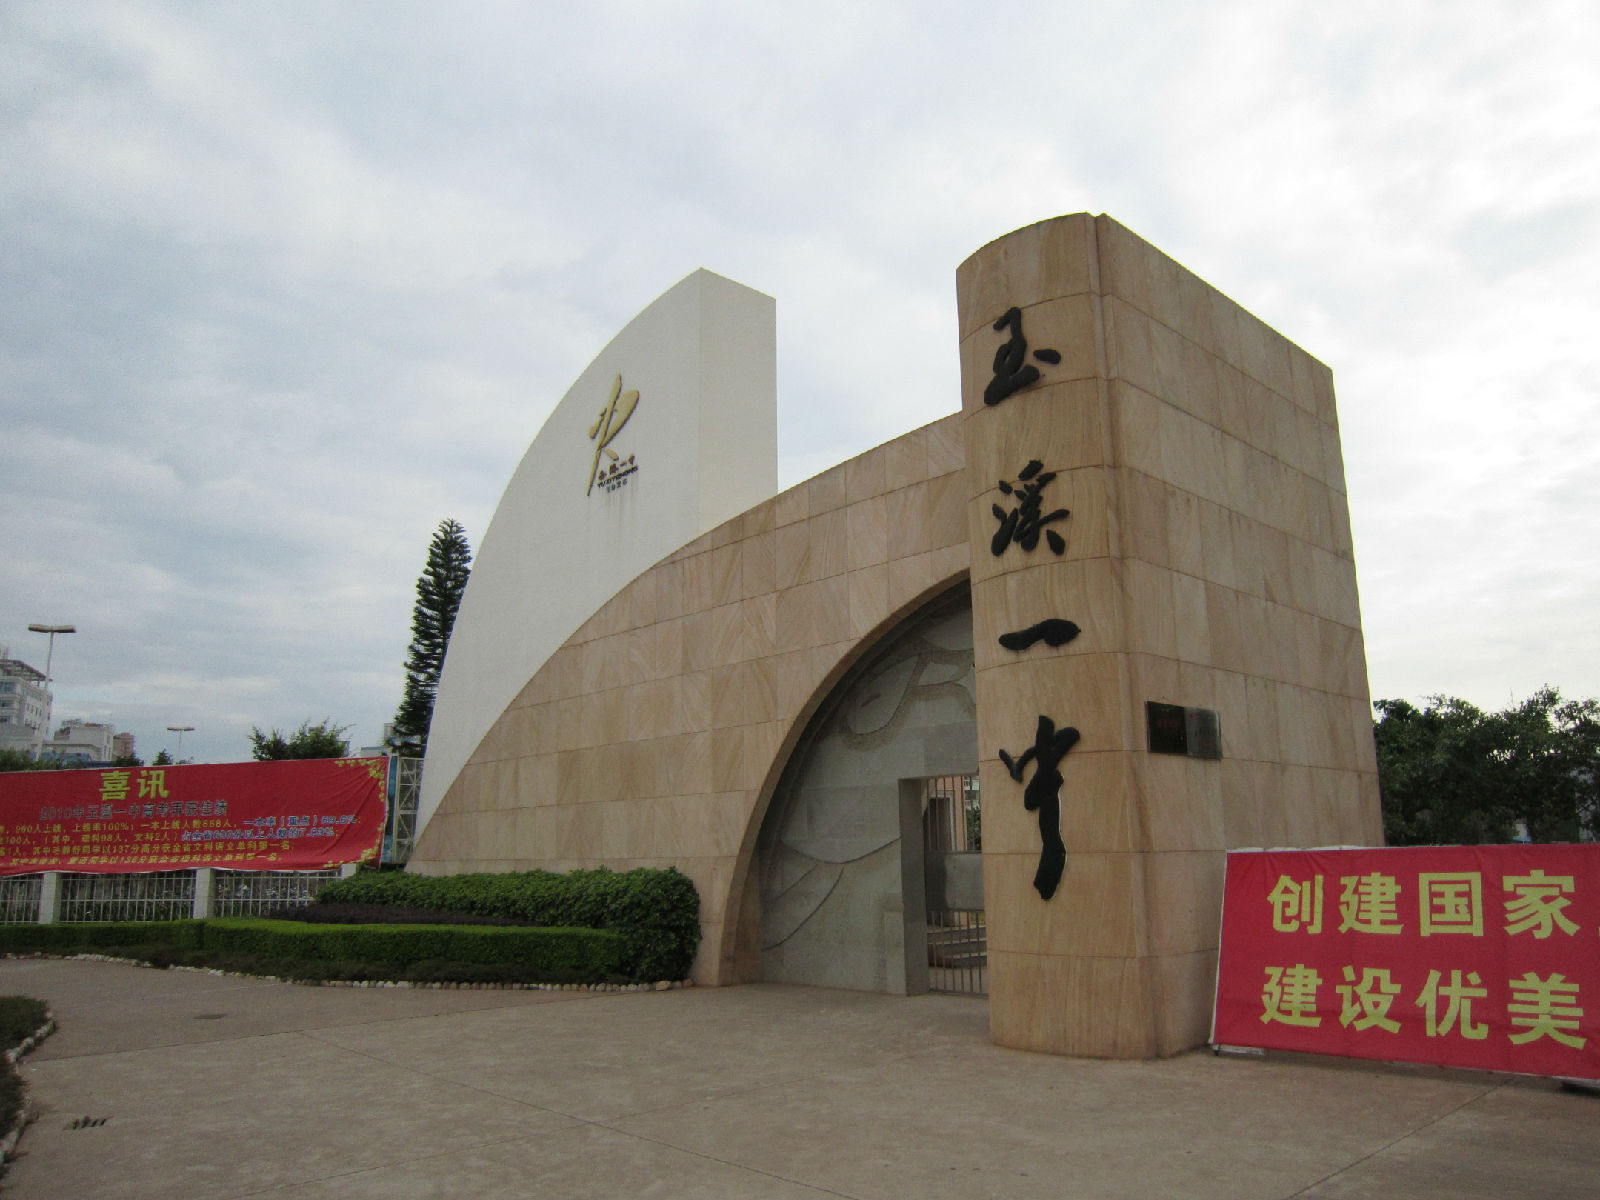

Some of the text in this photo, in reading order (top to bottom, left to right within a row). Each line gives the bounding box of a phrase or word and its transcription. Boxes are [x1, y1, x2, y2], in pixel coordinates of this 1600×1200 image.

[984, 307, 1081, 900] 玉溪一中
[99, 770, 170, 801] 喜讯
[1267, 869, 1581, 940] 创建国家
[1259, 963, 1587, 1050] 建设优美
